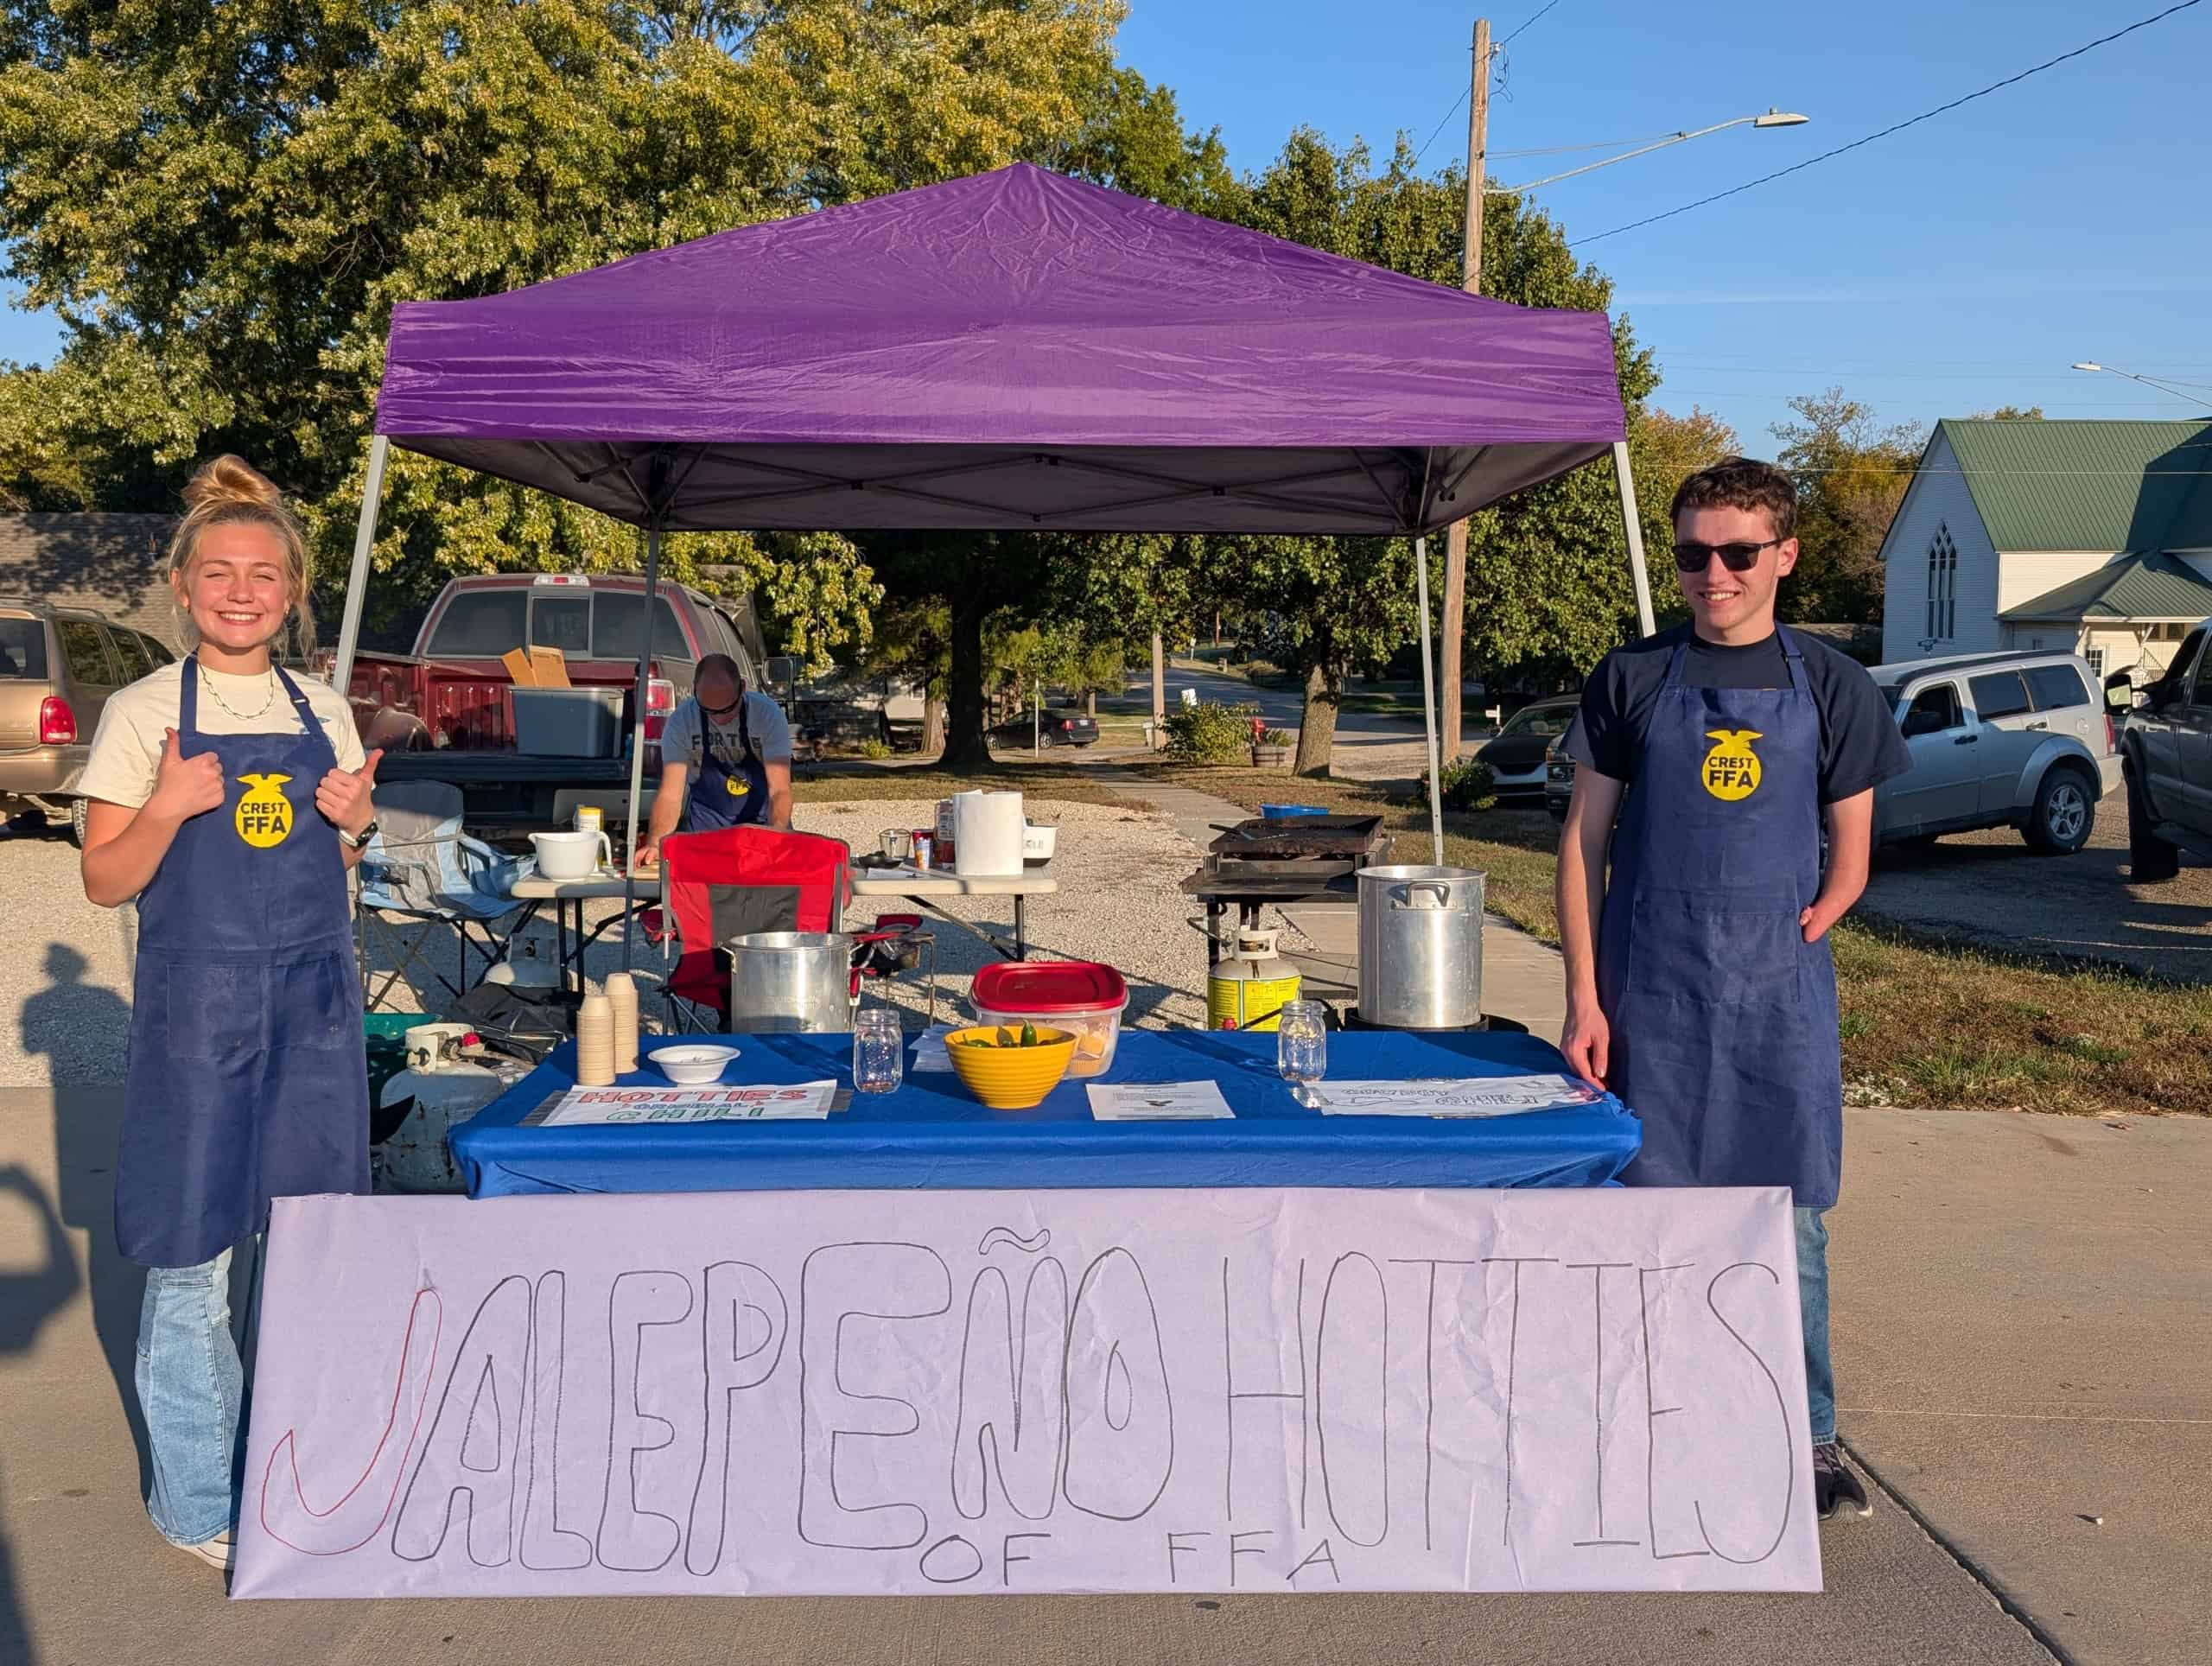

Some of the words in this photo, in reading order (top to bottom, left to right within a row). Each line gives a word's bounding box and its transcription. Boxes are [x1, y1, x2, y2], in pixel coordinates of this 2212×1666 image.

[1707, 756, 1754, 769] CREST
[1708, 770, 1754, 788] FFA
[240, 802, 286, 815] CREST
[242, 815, 287, 835] FFA
[577, 1089, 808, 1104] HOTTIES
[607, 1106, 766, 1121] CHILI
[260, 1226, 1173, 1576] JALEPEÑO
[1223, 1250, 1794, 1564] HOTTIES
[919, 1532, 1052, 1586] OF
[1166, 1529, 1341, 1587] FFA
